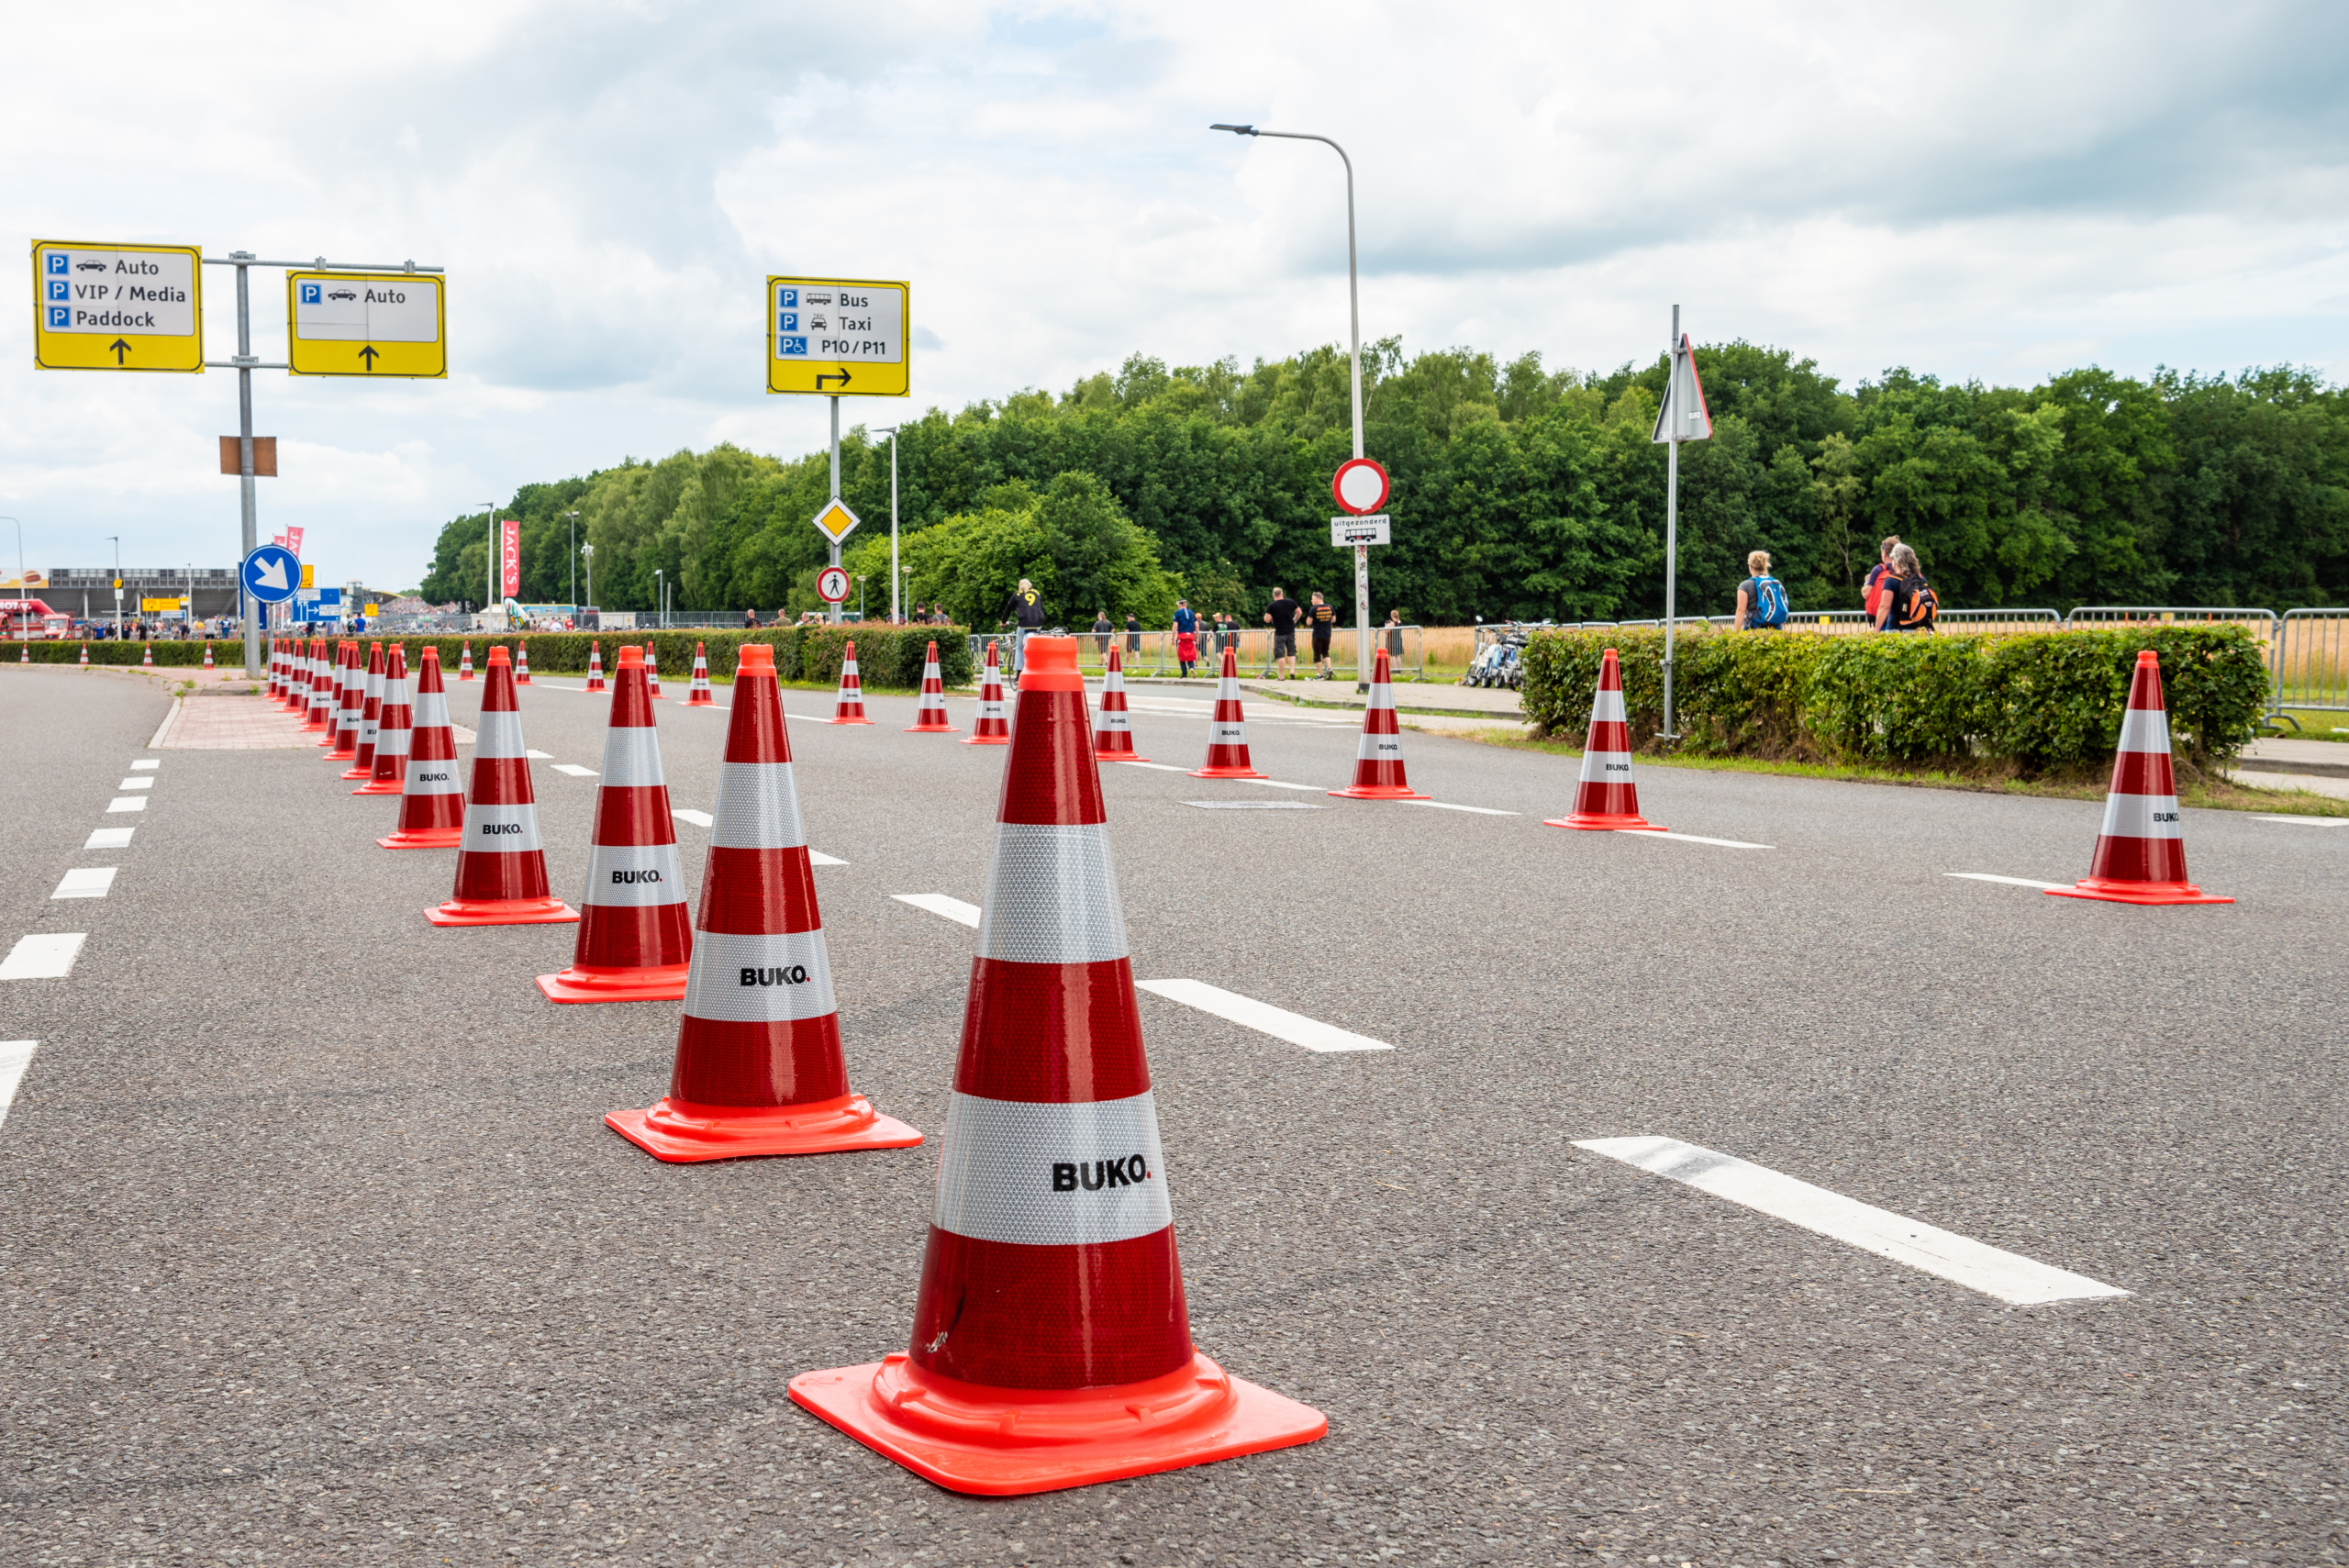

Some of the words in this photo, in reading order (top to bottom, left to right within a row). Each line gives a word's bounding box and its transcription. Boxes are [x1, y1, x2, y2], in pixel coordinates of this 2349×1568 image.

[115, 260, 160, 275] Auto
[75, 284, 109, 300] VIP
[115, 285, 124, 300] /
[129, 286, 186, 302] Media
[364, 288, 406, 305] Auto
[840, 293, 869, 307] Bus
[76, 310, 155, 328] Paddock
[839, 317, 872, 331] Taxi
[821, 339, 850, 354] P10
[852, 340, 860, 354] /
[863, 341, 886, 355] P11
[1334, 517, 1386, 527] uitgezonderd
[506, 527, 518, 585] JACK'S
[1024, 593, 1036, 606] 9
